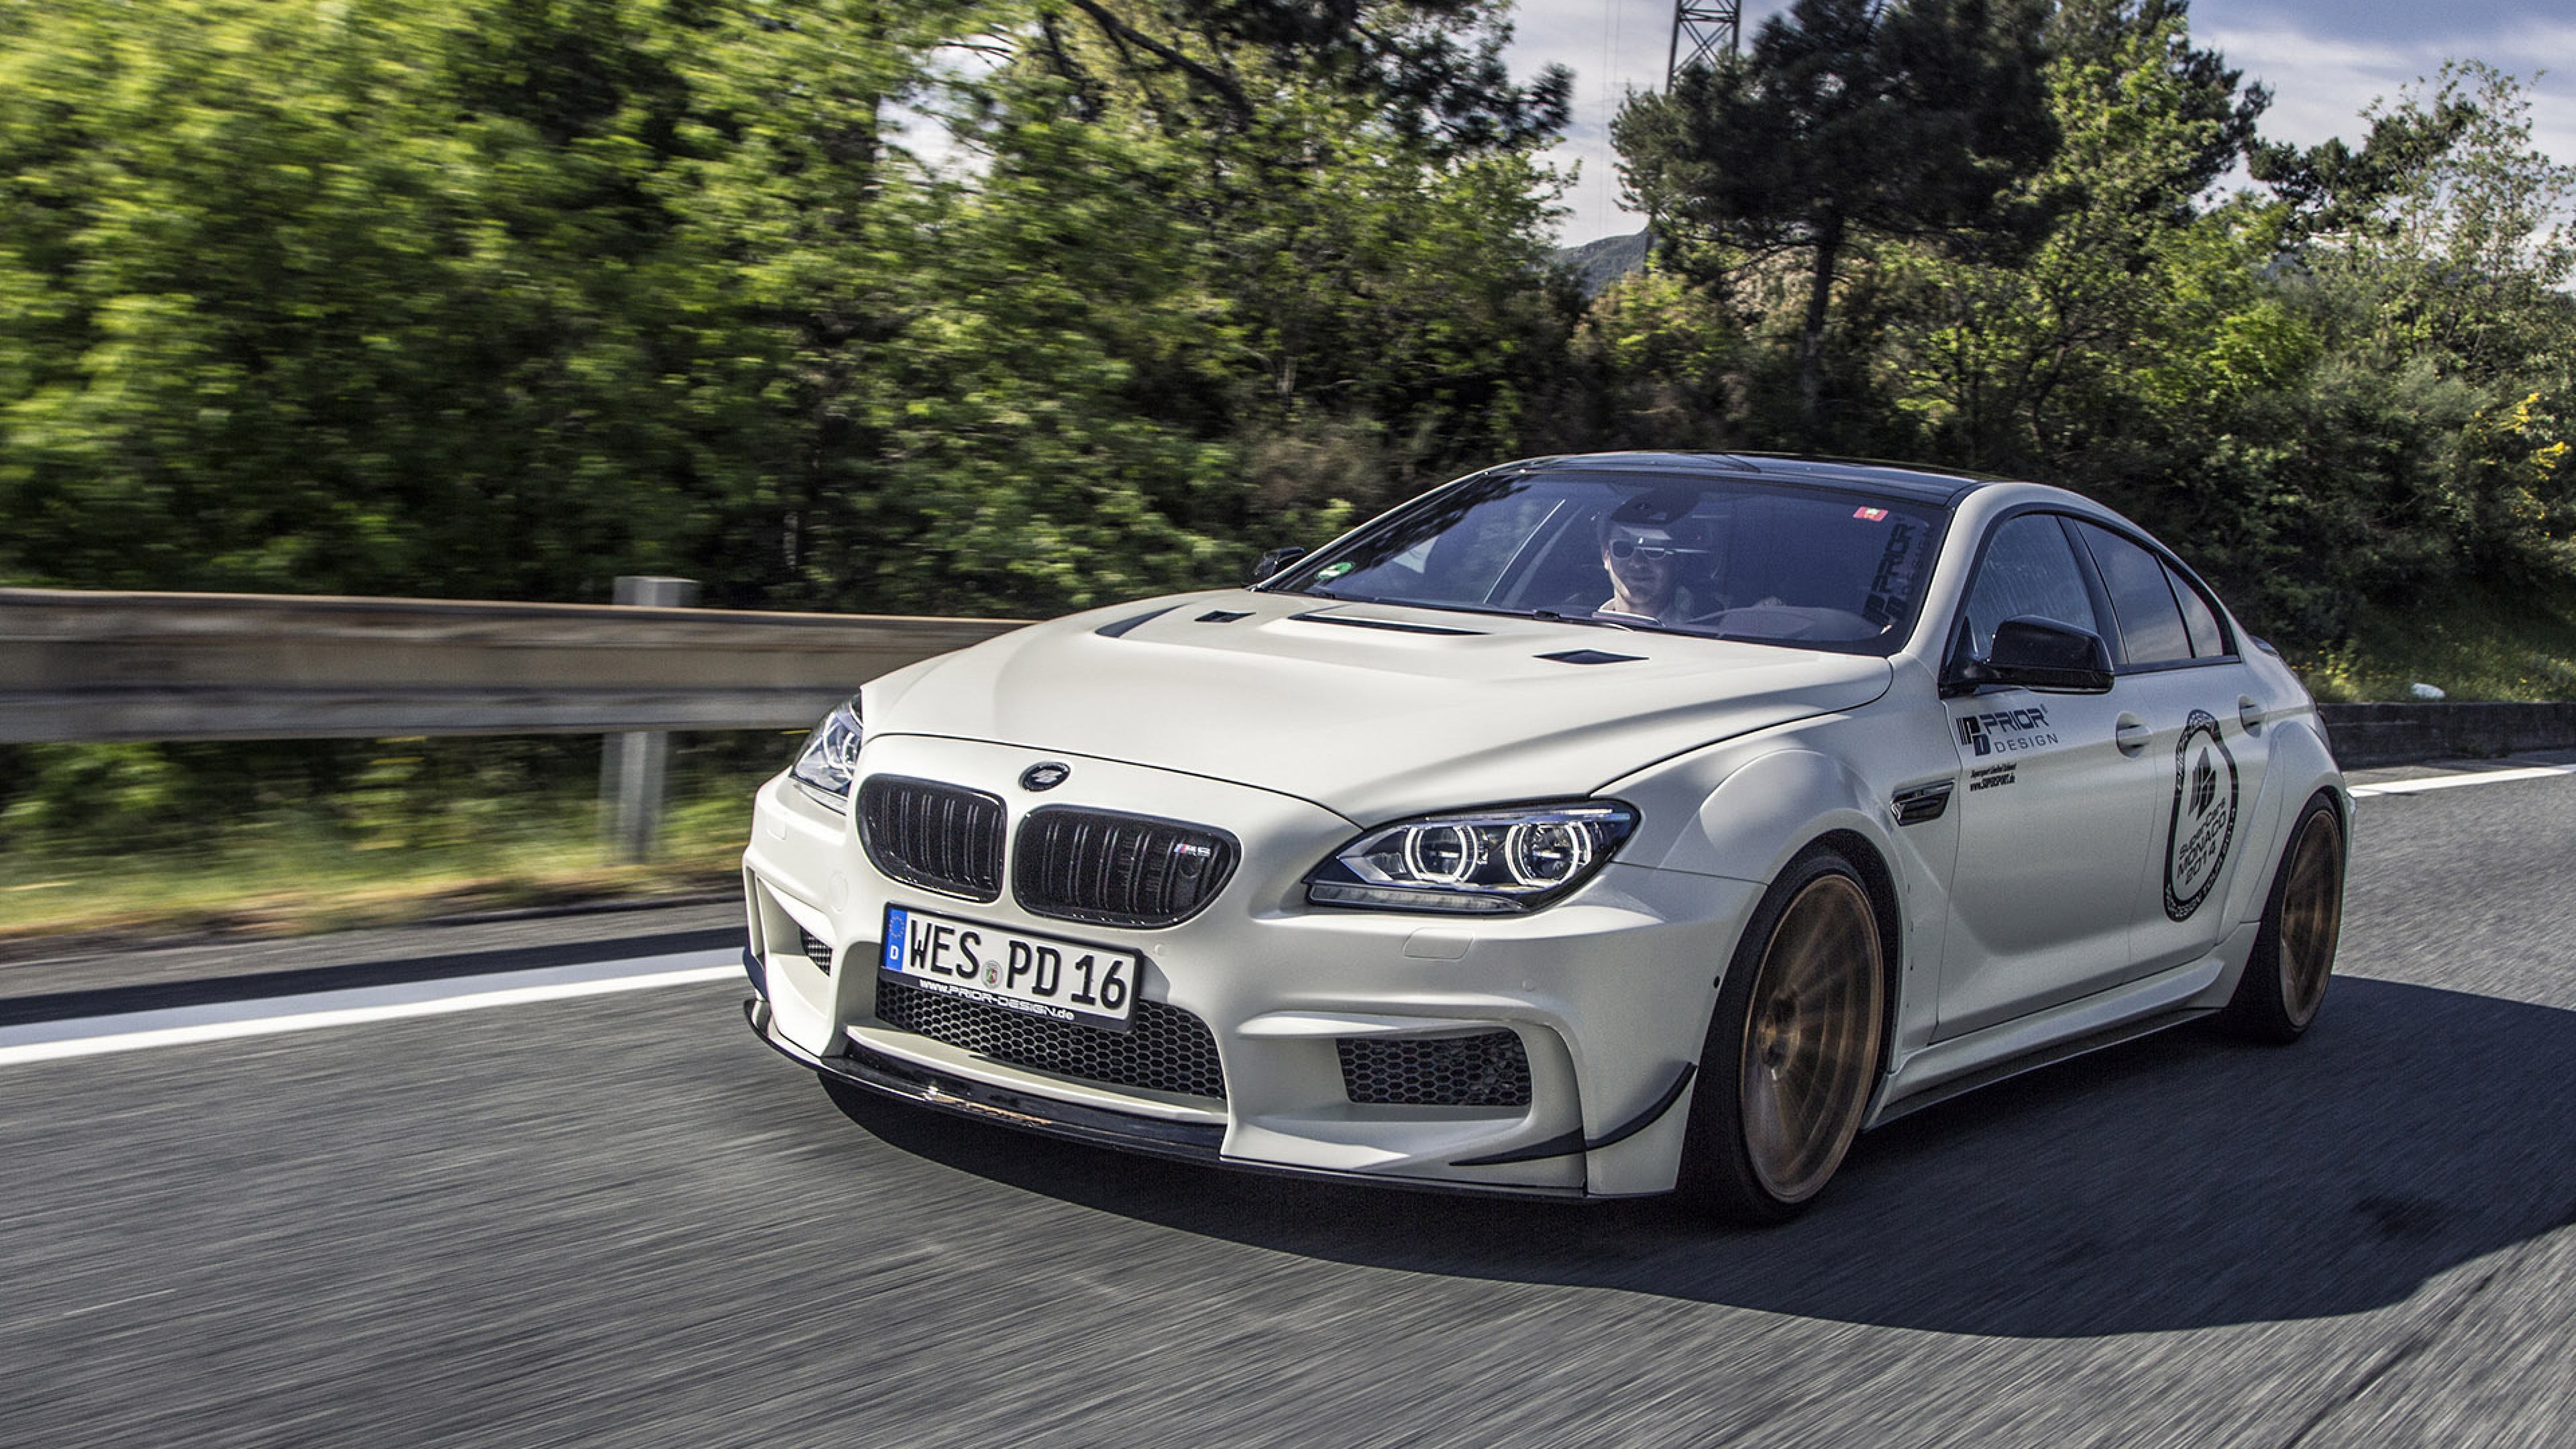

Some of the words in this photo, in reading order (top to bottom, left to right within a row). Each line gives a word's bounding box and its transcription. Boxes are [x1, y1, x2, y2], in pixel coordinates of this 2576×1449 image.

[1979, 708, 2049, 735] PRIOR
[1994, 733, 2059, 753] DESIGN
[1185, 845, 1211, 857] M6
[890, 945, 898, 960] D
[910, 919, 982, 979] WES
[1007, 939, 1062, 997] PD
[1071, 954, 1128, 1010] 16
